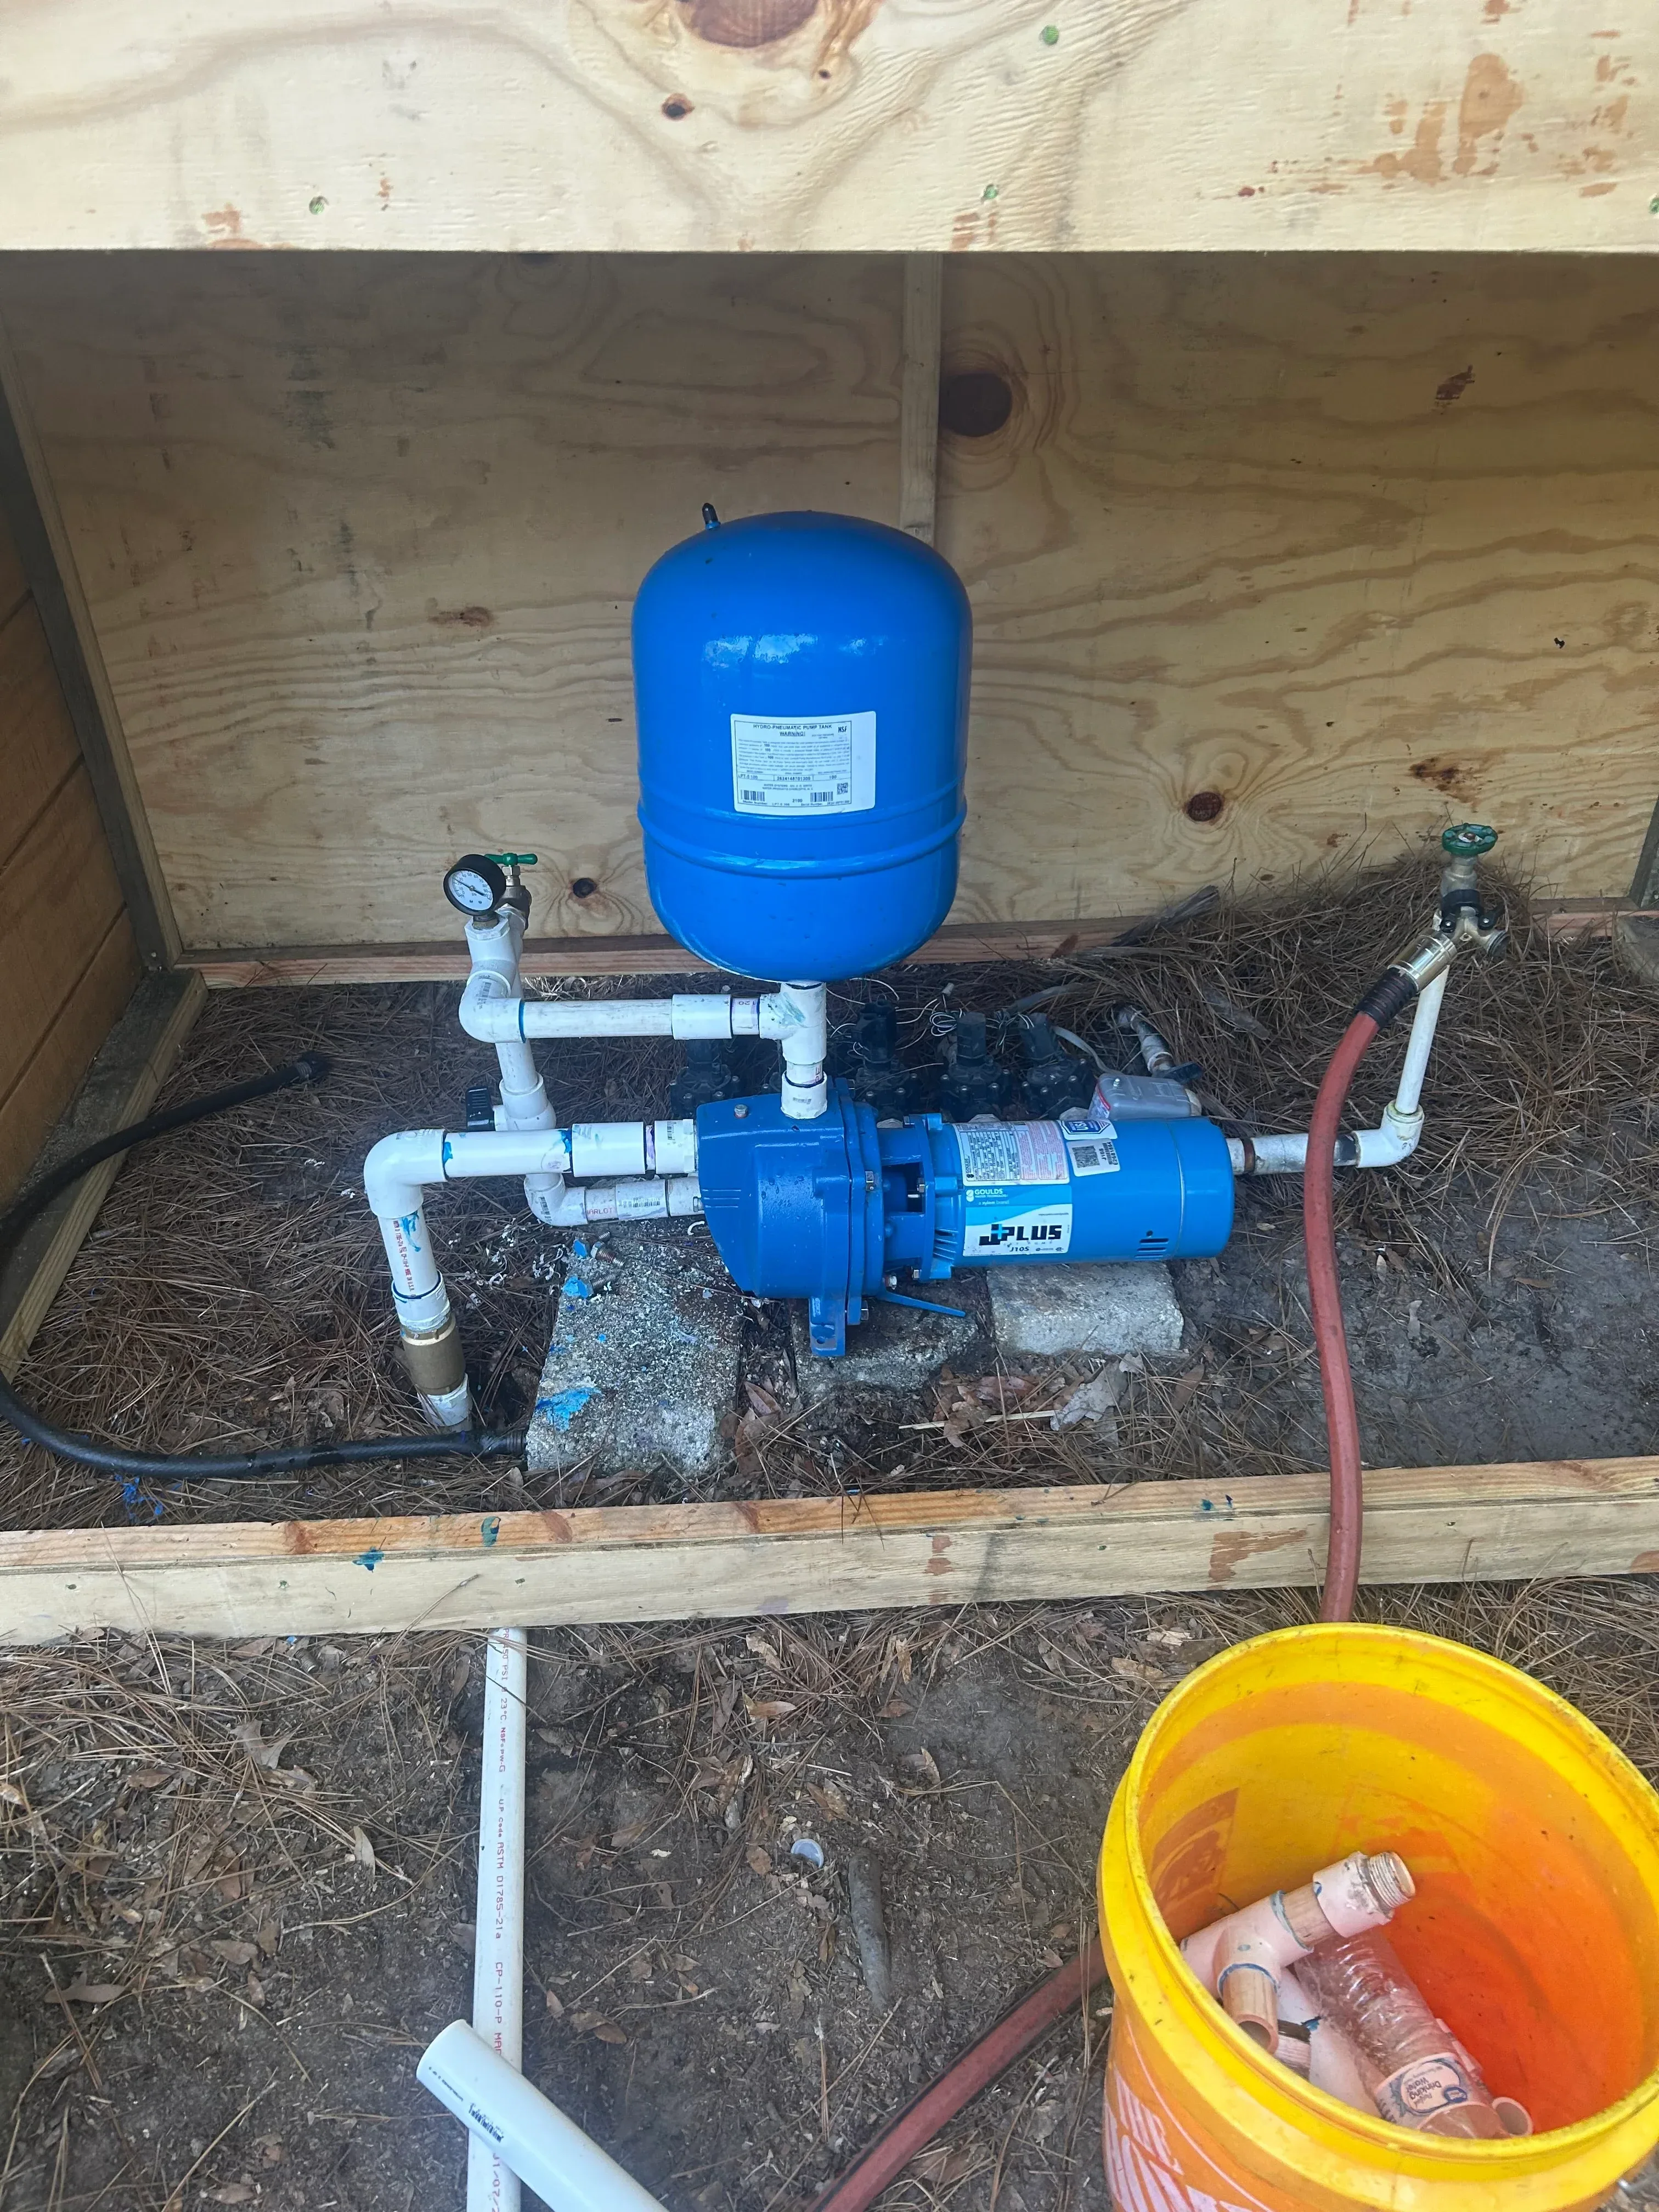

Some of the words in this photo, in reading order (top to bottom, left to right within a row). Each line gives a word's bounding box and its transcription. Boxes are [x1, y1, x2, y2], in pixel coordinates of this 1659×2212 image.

[496, 1875, 504, 1939] D1785-21a
[494, 1962, 503, 2024] CP-110-P
[1409, 2080, 1442, 2100] Drinking
